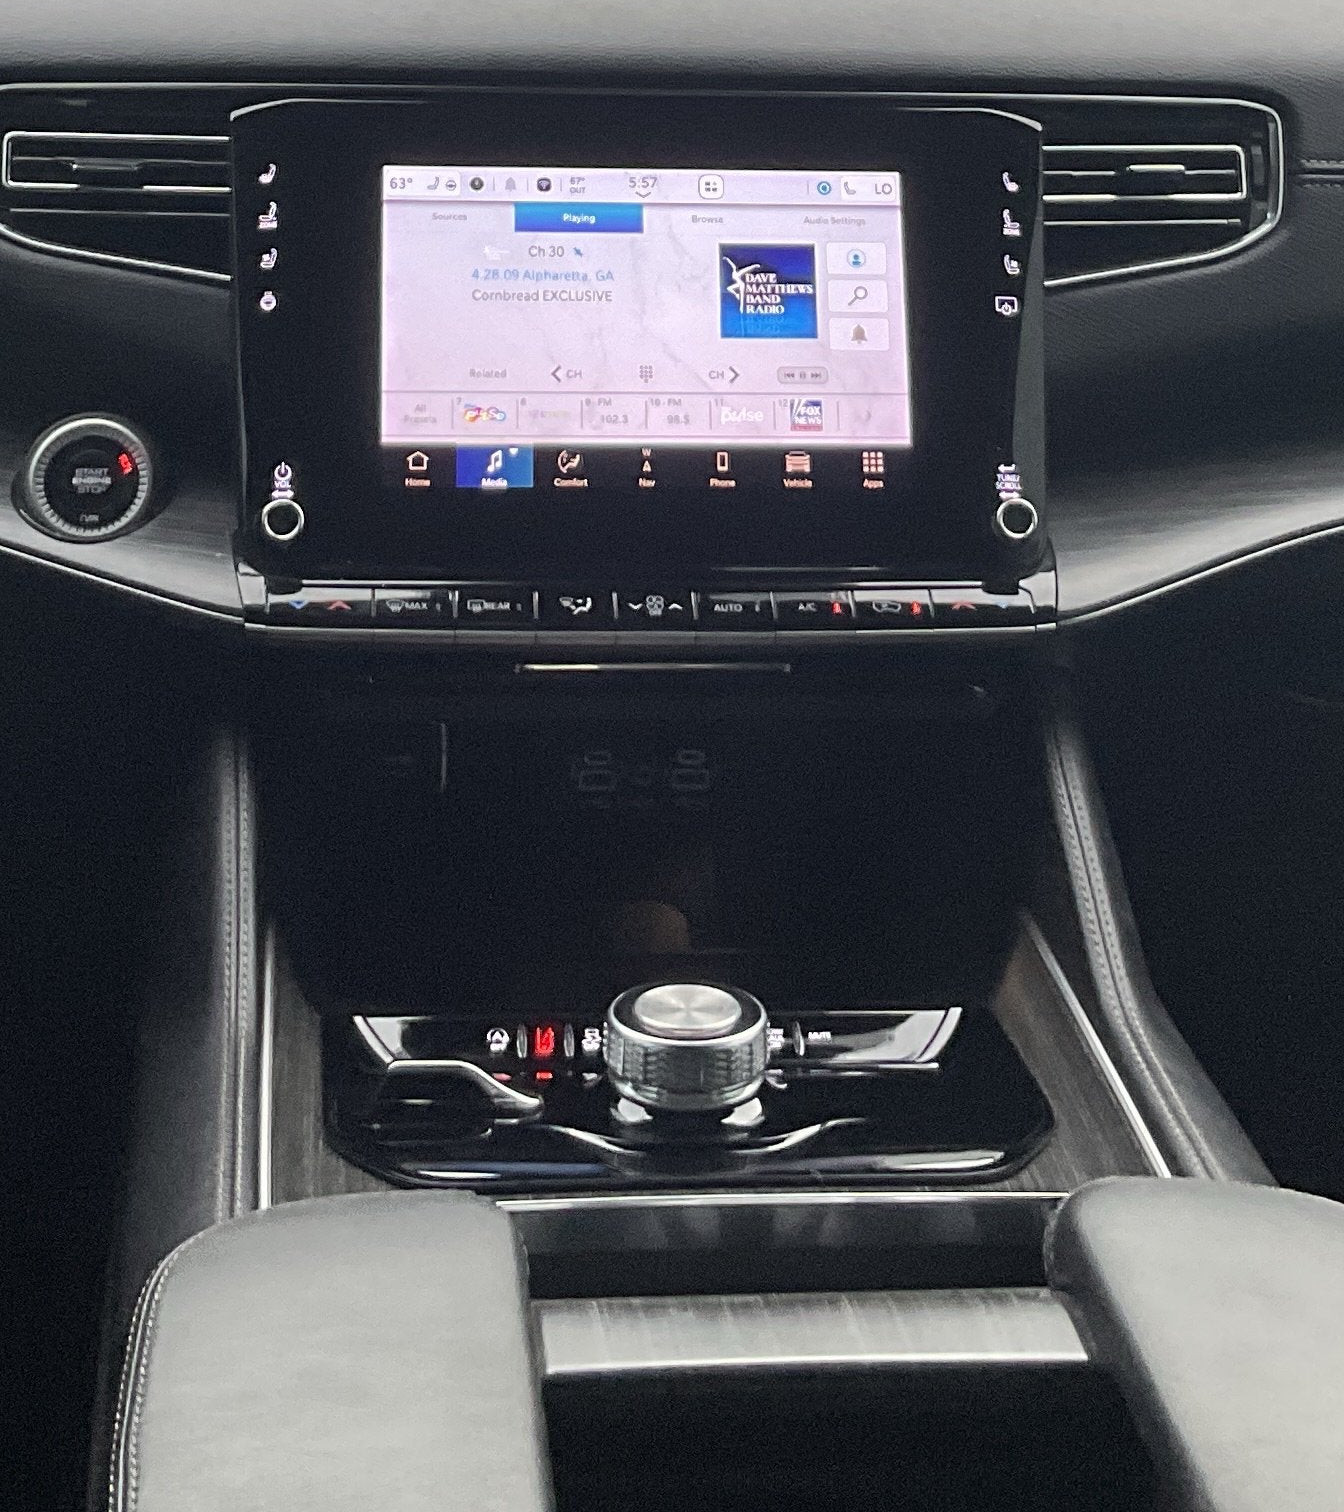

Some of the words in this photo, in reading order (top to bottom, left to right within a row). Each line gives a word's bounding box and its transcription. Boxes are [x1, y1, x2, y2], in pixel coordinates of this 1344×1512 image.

[389, 176, 413, 189] 63°
[628, 176, 658, 189] 5:57
[874, 183, 893, 195] LO
[432, 212, 467, 222] Sources
[562, 213, 596, 224] Playing
[691, 215, 724, 224] Browse
[803, 216, 829, 225] Audio
[830, 216, 866, 226] Settings
[528, 245, 546, 258] Ch
[548, 245, 565, 258] 30
[595, 270, 615, 281] GA
[745, 273, 777, 283] DAVE
[745, 283, 814, 294] MATTHEWS
[471, 289, 540, 302] Cornbread
[542, 290, 613, 302] EXCLUSIVE
[746, 294, 781, 304] BAND
[746, 304, 785, 314] RADIO
[469, 368, 507, 379] Related
[566, 369, 583, 379] CH
[708, 370, 725, 380] CH
[799, 406, 821, 416] FOX
[794, 417, 822, 425] NEWS
[75, 467, 109, 478] START
[274, 480, 292, 488] VOL
[404, 478, 431, 487] Home
[481, 478, 508, 487] Media
[554, 478, 589, 487] Comfort
[709, 478, 736, 488] Phone
[783, 478, 813, 488] Vehicle
[863, 478, 885, 489] Apps
[404, 601, 428, 610] MAX
[484, 601, 511, 610] REAR
[713, 603, 743, 612] AUTO
[798, 603, 817, 612] A/C
